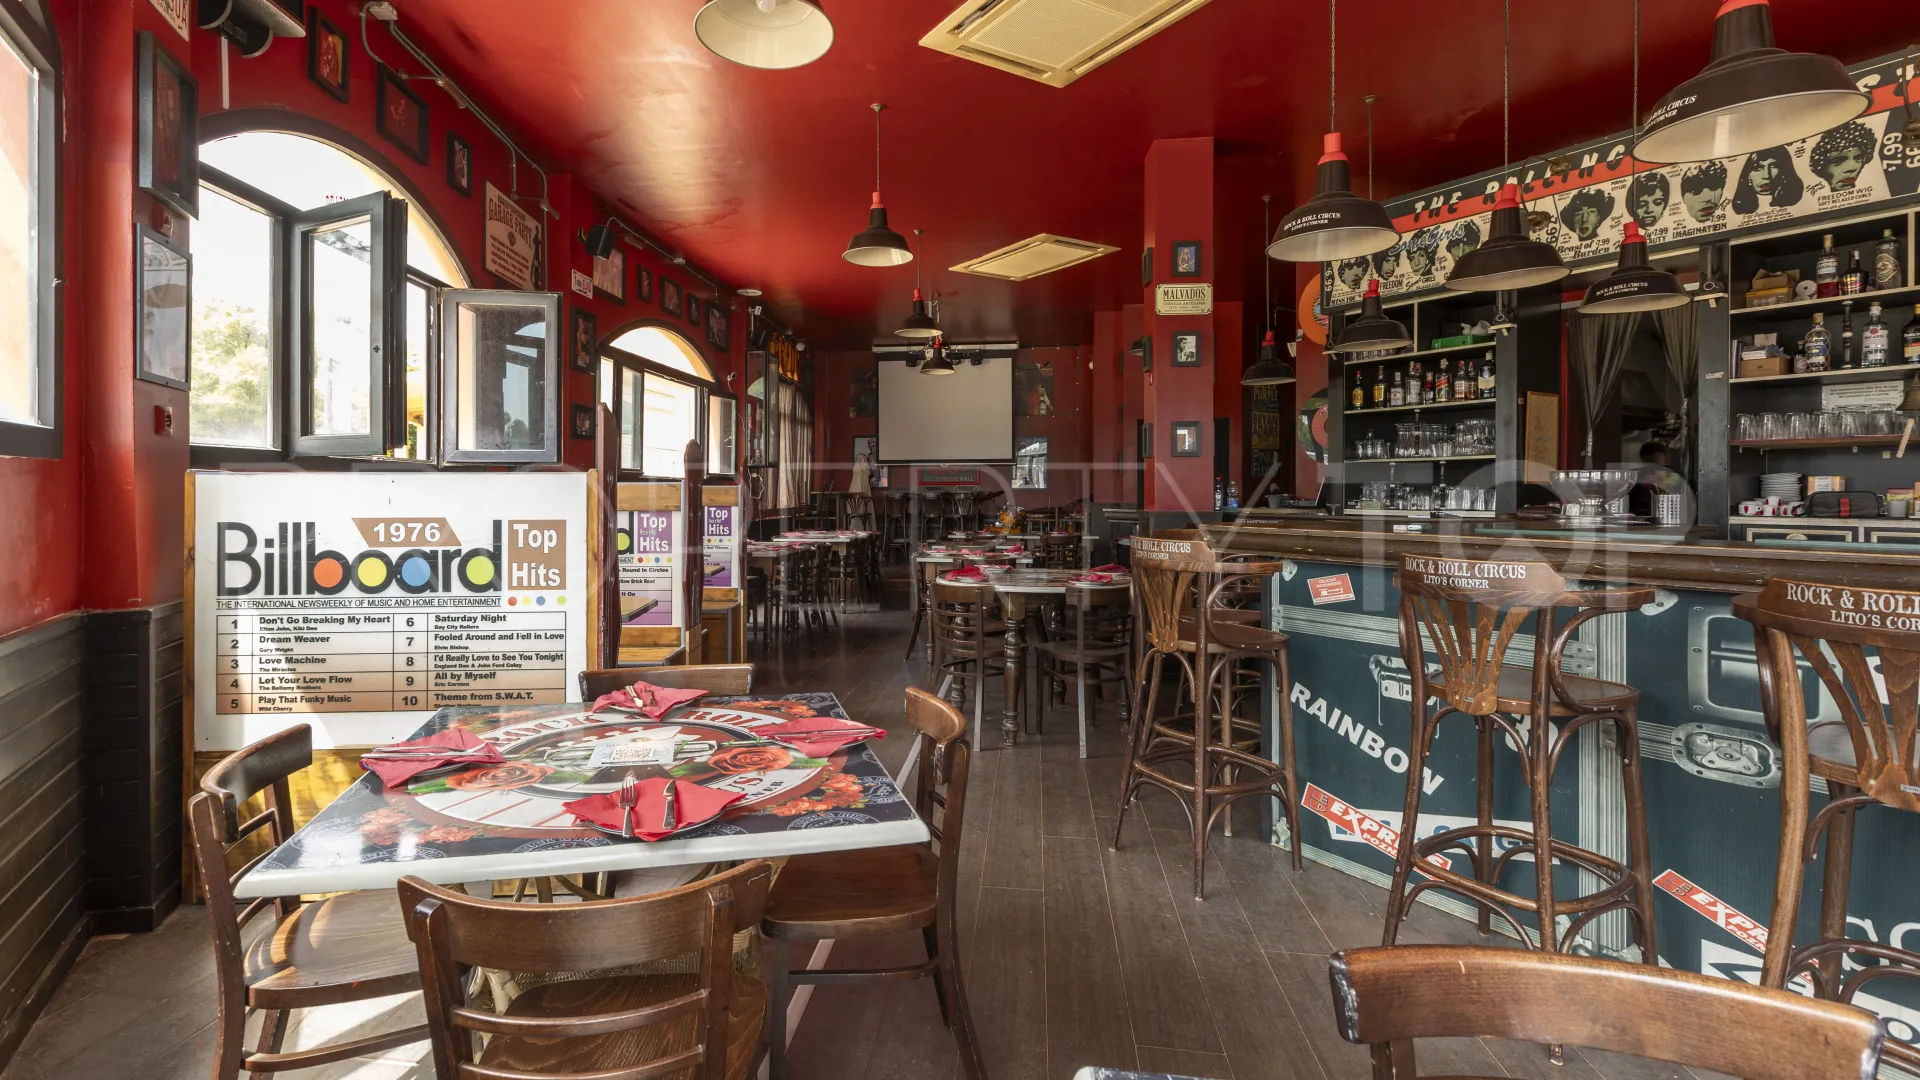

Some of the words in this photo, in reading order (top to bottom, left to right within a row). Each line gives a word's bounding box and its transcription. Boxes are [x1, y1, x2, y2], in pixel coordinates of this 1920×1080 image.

[1667, 95, 1698, 110] CIRCUS
[1817, 190, 1854, 203] FREEDOM
[1855, 186, 1873, 194] WIG
[1414, 191, 1462, 222] THE
[488, 198, 514, 229] GARAGE
[515, 215, 533, 250] PARTY
[1284, 220, 1296, 231] ROCK
[1301, 215, 1318, 223] ROLL
[1672, 222, 1727, 239] IMAGINATION
[1388, 238, 1427, 256] Some
[1427, 225, 1466, 252] Girls
[1557, 243, 1583, 254] Beast
[1584, 240, 1595, 249] of
[1573, 247, 1610, 259] Burden
[1379, 279, 1403, 291] FREEDOM
[1163, 288, 1206, 300] MALVADOS
[1253, 389, 1279, 400] PURPLE
[1253, 413, 1278, 425] BRYAN
[708, 507, 728, 520] Top
[640, 513, 667, 531] Top
[373, 522, 441, 542] 1976
[708, 524, 730, 535] Hits
[513, 523, 557, 554] Top
[639, 537, 669, 552] Hits
[1142, 540, 1160, 551] ROLL
[1160, 542, 1191, 553] CIRCUS
[217, 519, 502, 596] Billboard
[1147, 552, 1169, 560] CORNER
[1405, 557, 1425, 573] ROCK
[1427, 562, 1435, 574] &
[1437, 561, 1471, 577] ROLL
[1474, 563, 1527, 579] CIRCUS
[511, 562, 561, 587] Hits
[1449, 577, 1490, 589] CORNER
[1785, 582, 1834, 606] ROCK
[1840, 589, 1855, 609] &
[217, 600, 232, 609] THE
[234, 600, 296, 609] INTERNATIONAL
[298, 599, 352, 608] NEWSWEEKLY
[354, 599, 365, 608] OF
[367, 598, 393, 608] MUSIC
[394, 598, 411, 607] AND
[412, 597, 436, 607] HOME
[437, 597, 501, 606] ENTERTAINMENT
[286, 616, 300, 624] Go
[302, 616, 345, 625] Breaking
[347, 616, 362, 625] My
[364, 615, 391, 623] Heart
[406, 617, 414, 627] 6
[434, 614, 478, 623] Saturday
[481, 614, 507, 623] Night
[1886, 616, 1920, 631] COR
[231, 620, 238, 630] 1
[294, 635, 330, 643] Weaver
[406, 637, 414, 647] 7
[434, 633, 463, 641] Fooled
[516, 632, 531, 640] Fell
[534, 632, 542, 640] in
[544, 632, 564, 640] Love
[231, 639, 239, 649] 2
[231, 659, 239, 669] 3
[285, 656, 326, 664] Machine
[406, 656, 414, 666] 8
[446, 654, 470, 663] Really
[518, 653, 533, 661] You
[535, 653, 564, 662] Tonight
[278, 676, 300, 684] Your
[303, 676, 326, 684] Love
[406, 676, 414, 686] 9
[434, 672, 449, 680] All
[451, 672, 462, 681] by
[465, 671, 496, 681] Myself
[230, 679, 239, 689] 4
[259, 696, 276, 705] Play
[279, 695, 297, 703] That
[300, 695, 324, 704] Funky
[327, 695, 351, 703] Music
[402, 696, 418, 706] 10
[434, 693, 468, 701] Theme
[470, 692, 492, 700] from
[495, 692, 534, 700] S.W.A.T.
[230, 699, 239, 709] 5
[1290, 682, 1444, 796] RAINBOW
[1330, 800, 1445, 867] EXPRS
[1363, 832, 1399, 856] POZN
[1690, 892, 1769, 943] EXPR
[1726, 925, 1767, 951] POZN
